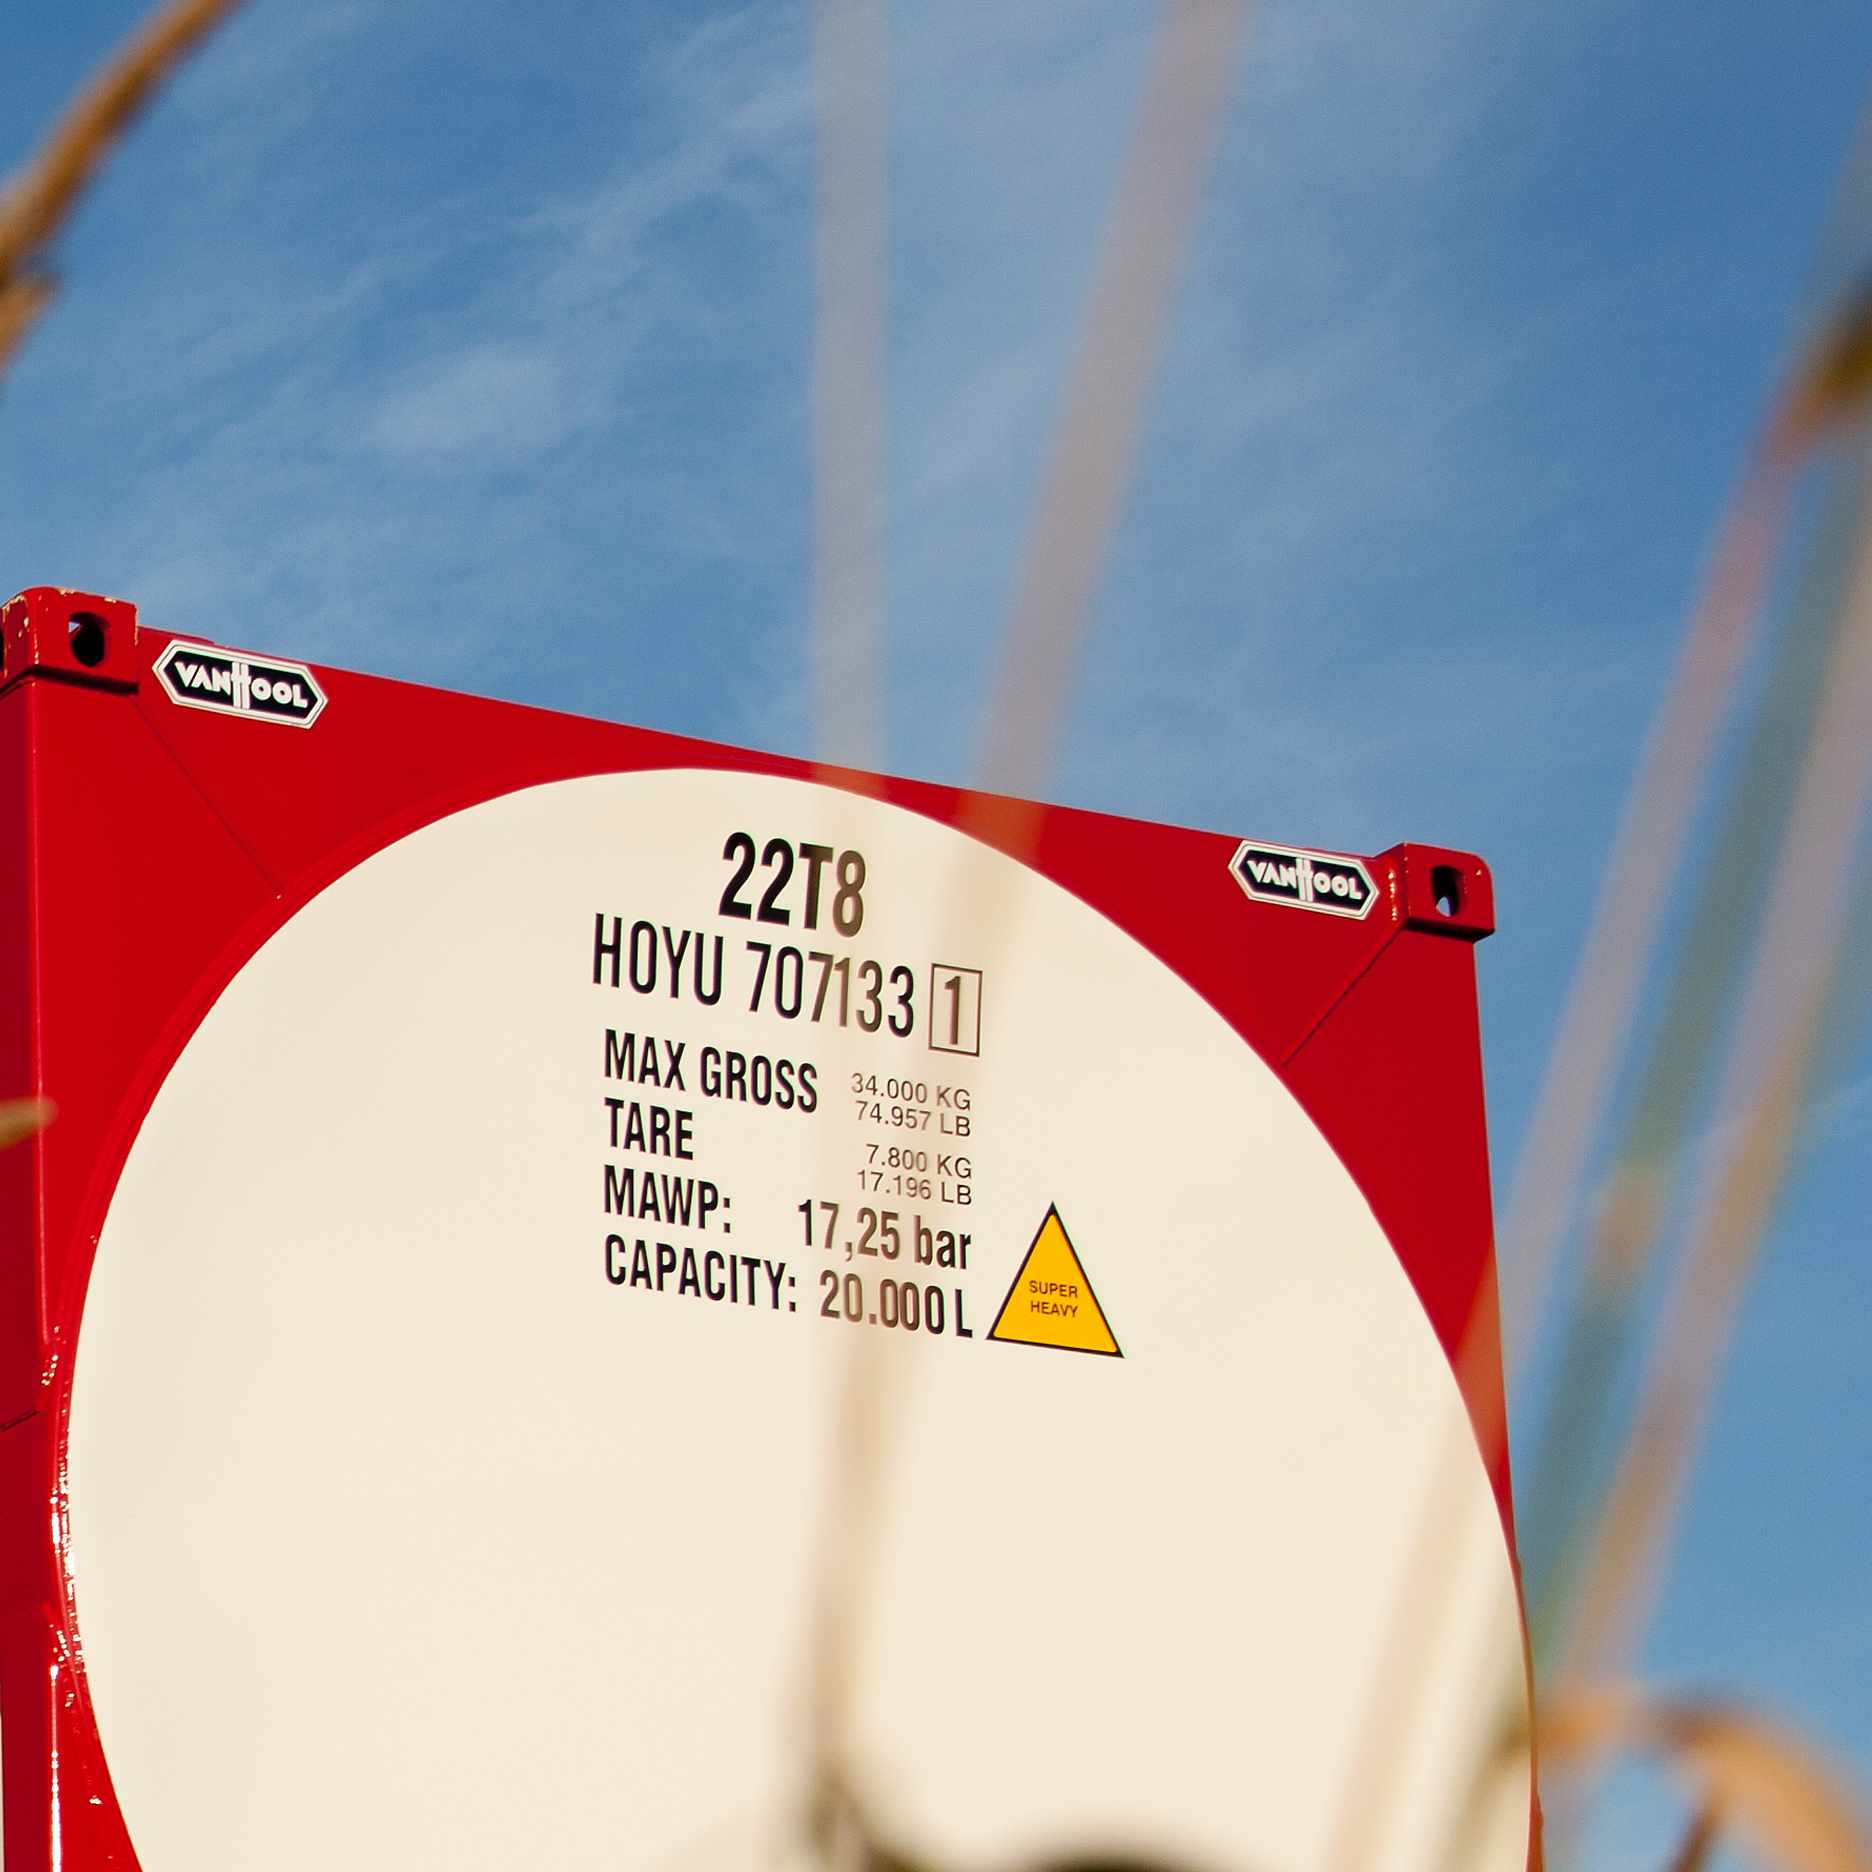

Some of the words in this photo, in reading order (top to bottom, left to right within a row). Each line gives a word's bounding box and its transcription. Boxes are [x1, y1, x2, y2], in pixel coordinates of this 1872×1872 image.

[718, 831, 867, 937] 22T8
[591, 913, 724, 1007] HOYU
[745, 940, 915, 1038] 707133
[944, 975, 961, 1046] 1
[604, 1028, 687, 1091] MAX
[700, 1046, 818, 1114] GROSS
[851, 1072, 928, 1104] 34.000
[935, 1085, 971, 1111] KG
[604, 1097, 694, 1160] TARE
[856, 1100, 932, 1131] 74.957
[939, 1113, 971, 1137] LB
[866, 1143, 928, 1173] 7.800
[936, 1153, 971, 1179] KG
[857, 1170, 932, 1200] 17.196
[940, 1181, 972, 1206] LB
[603, 1164, 732, 1234] MAWP:
[797, 1198, 901, 1263] 17,25
[913, 1215, 972, 1270] bar
[604, 1233, 798, 1313] CAPACITY:
[818, 1269, 944, 1335] 20.000
[954, 1289, 973, 1338] L
[1028, 1280, 1079, 1300] SUPER
[1029, 1300, 1079, 1319] HEAVY
